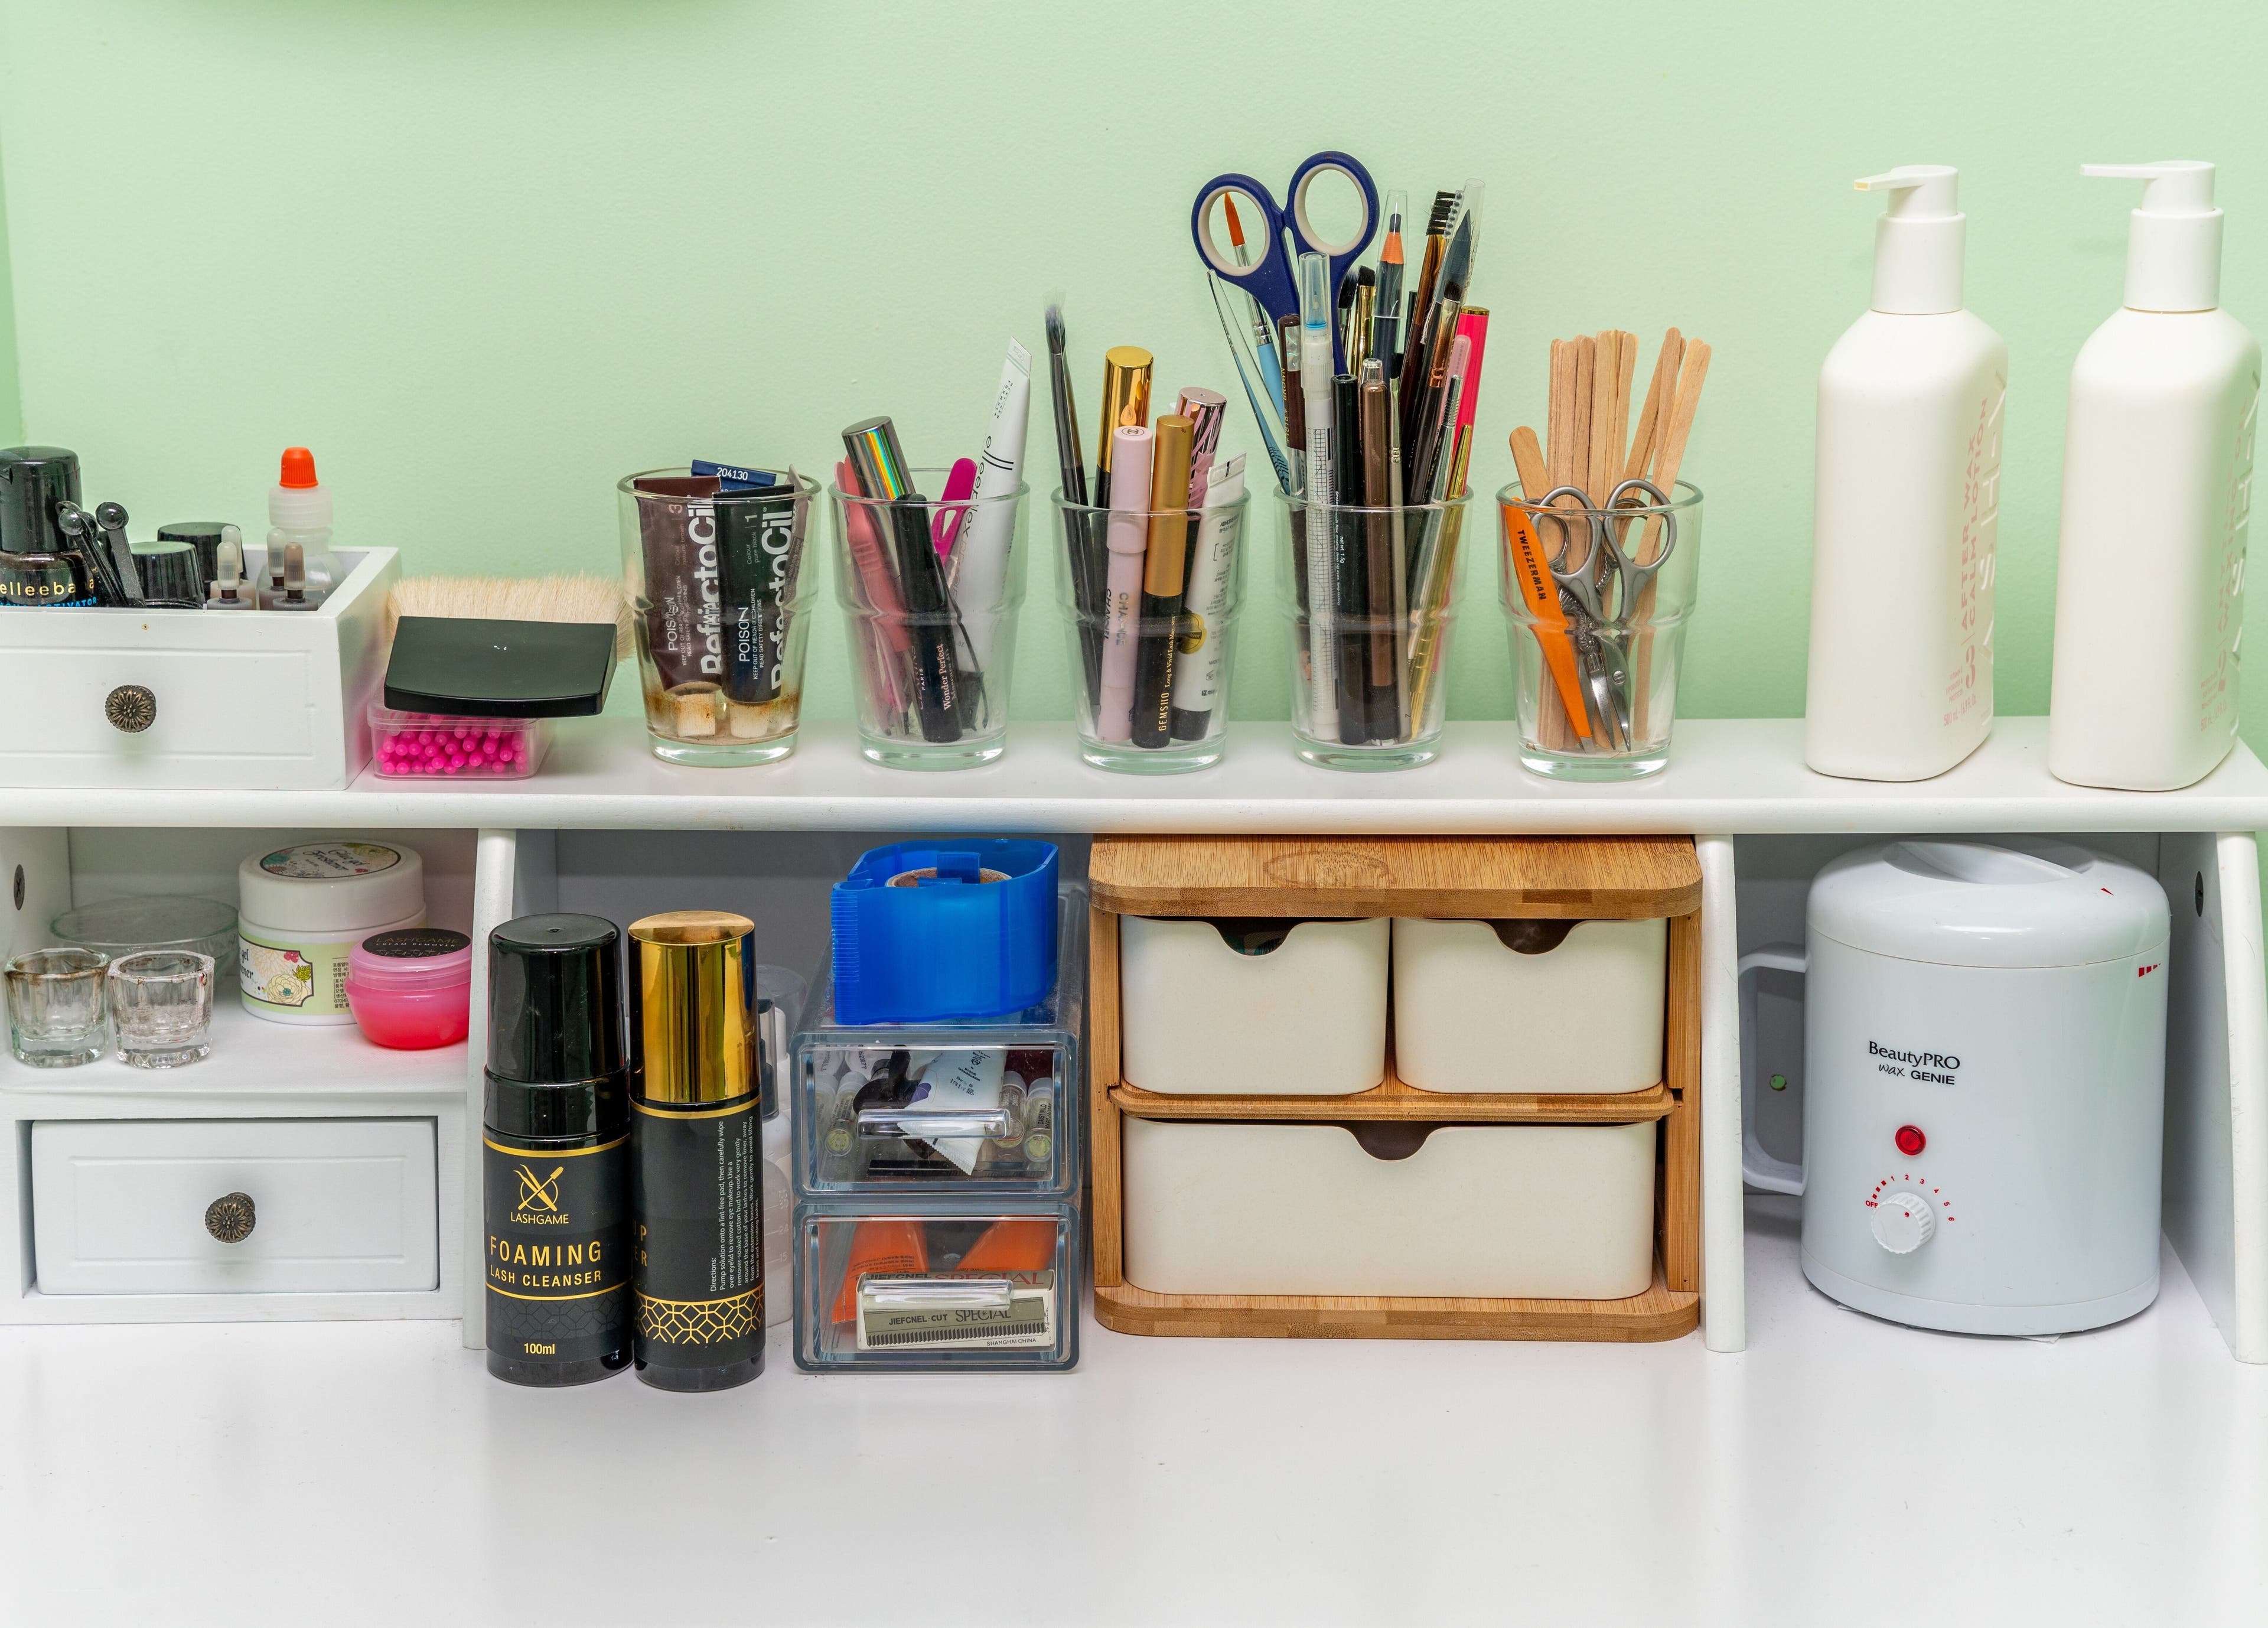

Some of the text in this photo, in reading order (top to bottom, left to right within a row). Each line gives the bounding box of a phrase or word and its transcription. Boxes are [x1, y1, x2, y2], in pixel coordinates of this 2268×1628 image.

[1971, 398, 1988, 523] LOTION
[716, 467, 748, 480] 204130
[669, 504, 683, 514] 3
[1961, 434, 1976, 631] AFTER WAX
[1517, 530, 1546, 600] TWEEZERMAN
[0, 581, 94, 596] elleebaa
[38, 597, 97, 607] IVATOR
[738, 607, 750, 662] POISON
[936, 643, 951, 710] Wonder Perfect
[1966, 644, 1976, 689] 3
[1158, 692, 1169, 731] GEMSHO
[1869, 1041, 1960, 1069] BeautyPRO
[1879, 1064, 1955, 1085] wax GENIE
[1865, 1200, 1878, 1209] OFF
[510, 1212, 569, 1225] LASHGAME
[490, 1235, 601, 1266] FOAMING
[490, 1265, 601, 1287] LASH CLEANSER
[955, 1310, 1011, 1323] SPECIAL
[524, 1342, 555, 1355] 100ml
